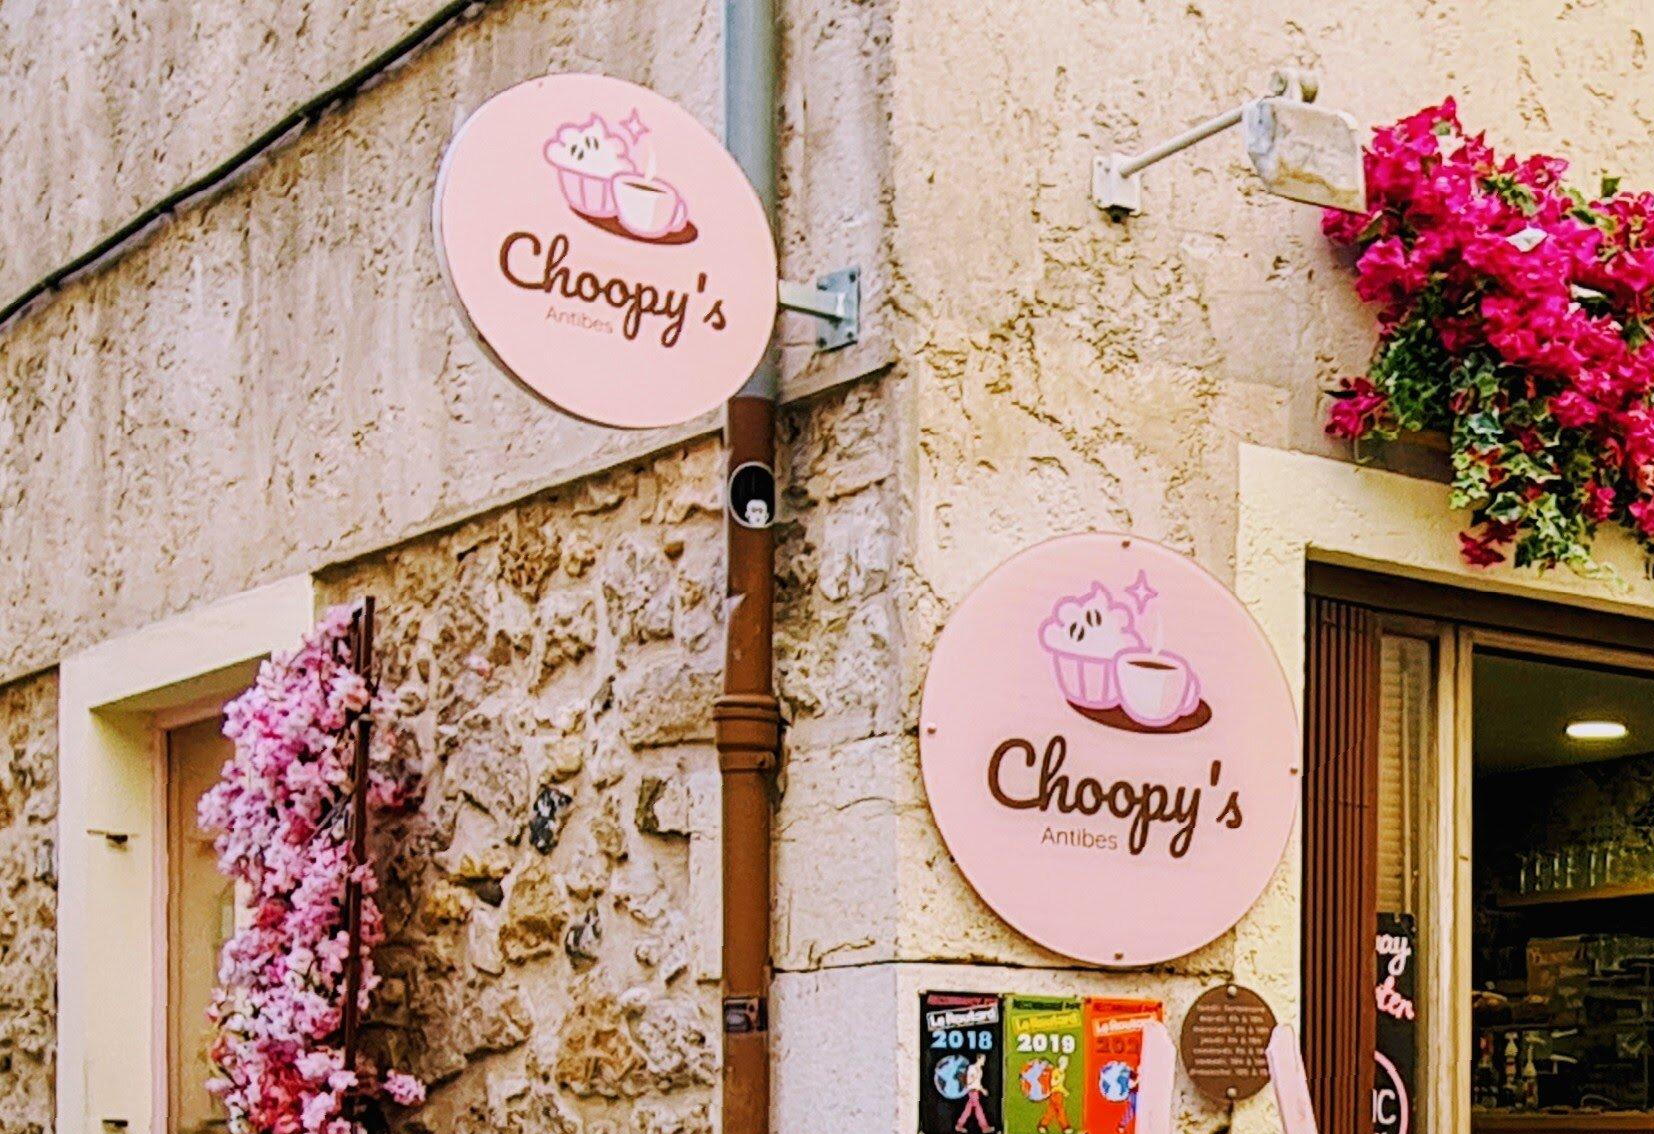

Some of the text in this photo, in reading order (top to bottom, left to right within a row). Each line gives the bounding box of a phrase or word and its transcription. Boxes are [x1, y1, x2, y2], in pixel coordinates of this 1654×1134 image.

[499, 231, 727, 348] Choopy's
[545, 305, 614, 334] Antibes
[988, 735, 1244, 859] Choopy's
[1041, 827, 1118, 851] Antibes
[930, 1030, 993, 1050] 2018
[1016, 1033, 1076, 1054] 2019
